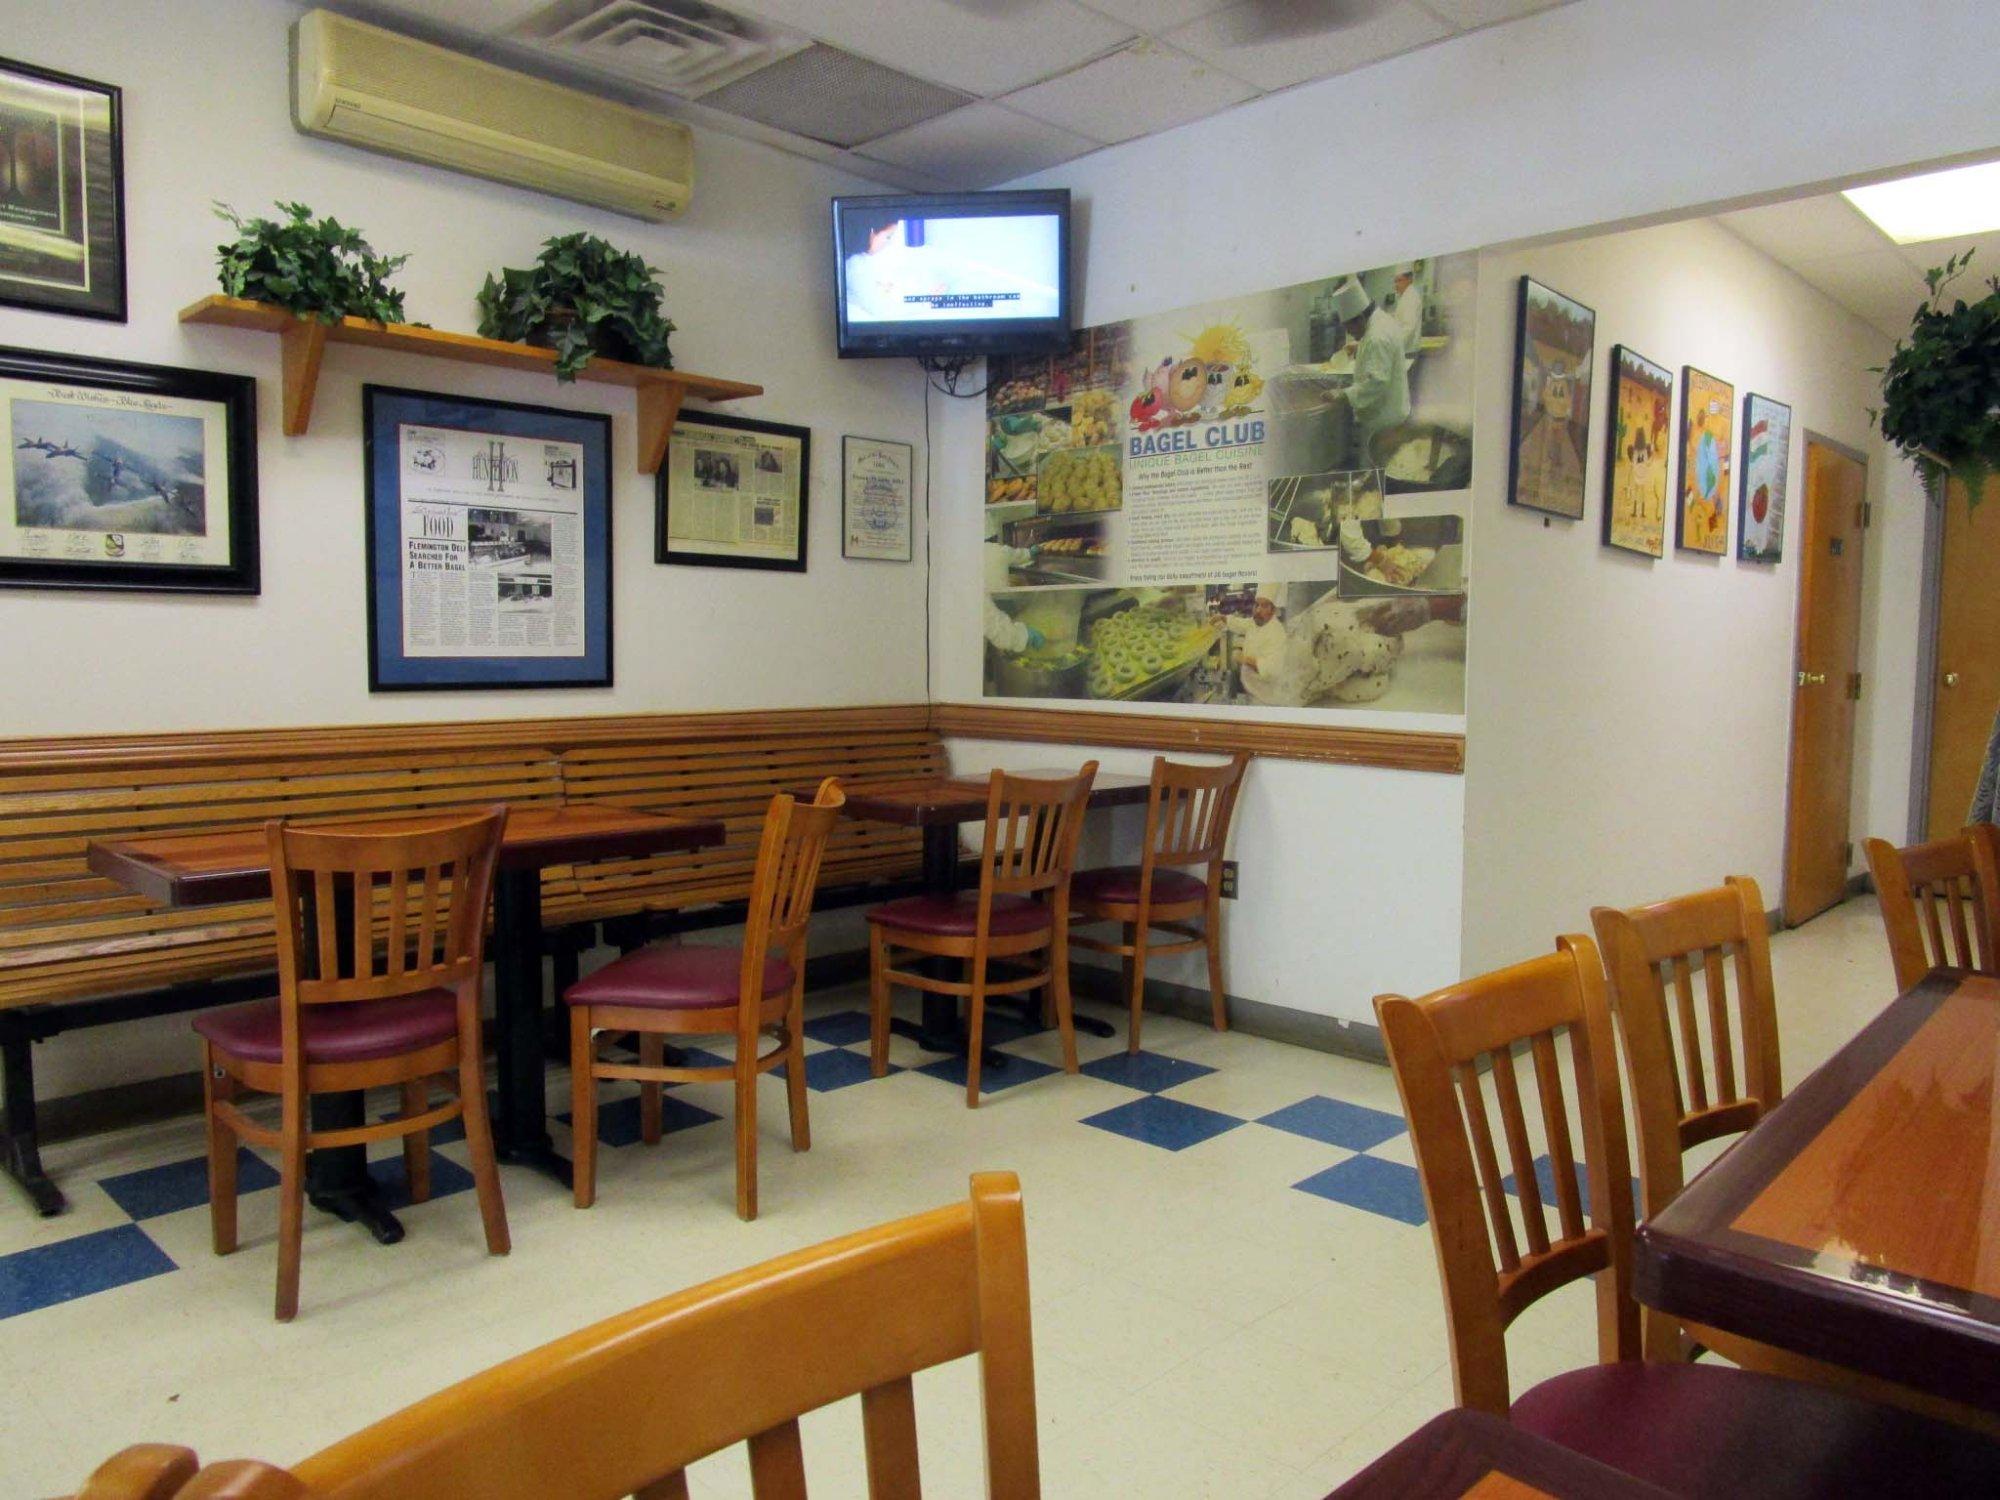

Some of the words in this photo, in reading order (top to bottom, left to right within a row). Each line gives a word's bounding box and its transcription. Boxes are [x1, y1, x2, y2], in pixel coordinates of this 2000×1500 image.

[1130, 430, 1197, 455] BAGEL
[1206, 421, 1265, 446] CLUB
[1129, 457, 1173, 470] UNIQUE
[1175, 451, 1212, 465] BAGEL
[1215, 445, 1265, 460] CUISINE
[1160, 469, 1176, 479] Bagel
